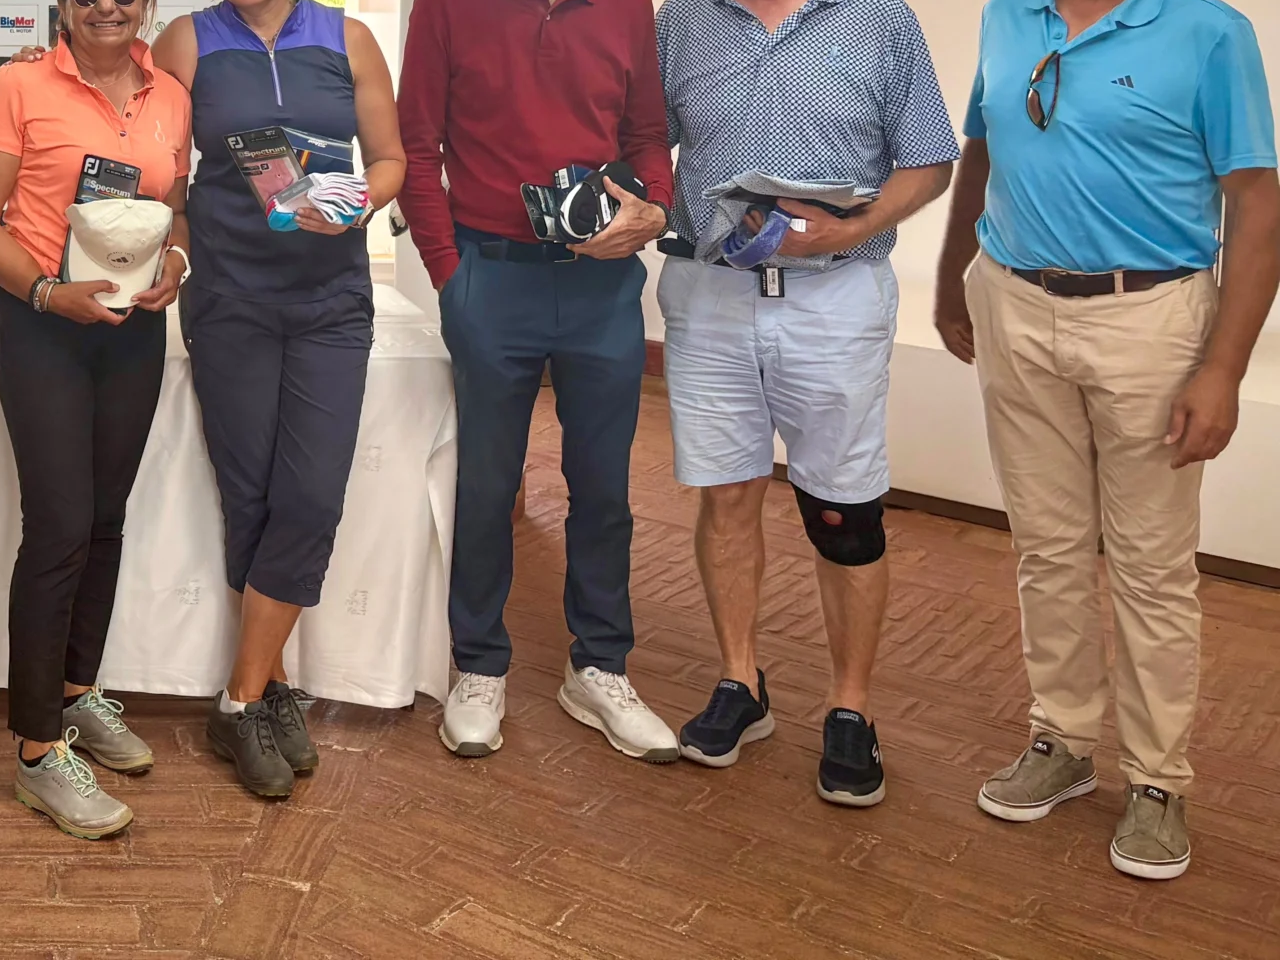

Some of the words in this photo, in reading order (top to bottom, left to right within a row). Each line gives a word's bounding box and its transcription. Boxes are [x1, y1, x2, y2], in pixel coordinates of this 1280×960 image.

[0, 16, 35, 27] BigMat
[227, 136, 244, 149] FJ
[243, 146, 286, 158] Spectrum
[84, 157, 100, 175] FJ
[90, 180, 131, 198] Spectrum
